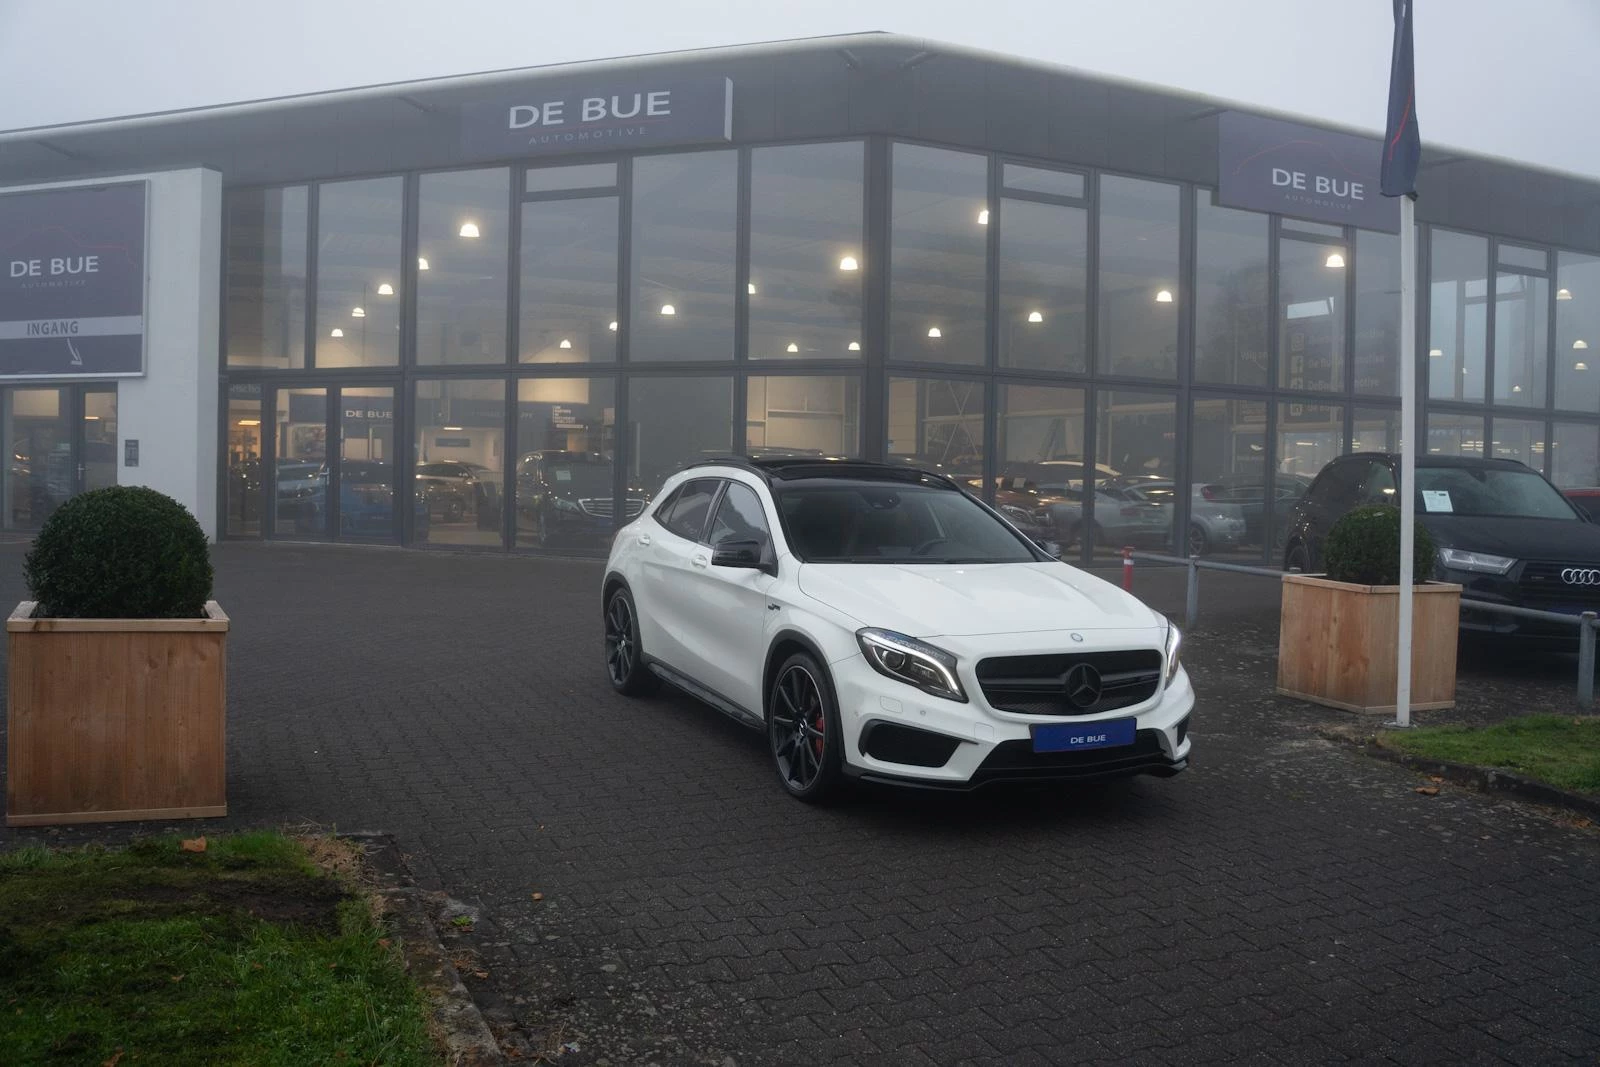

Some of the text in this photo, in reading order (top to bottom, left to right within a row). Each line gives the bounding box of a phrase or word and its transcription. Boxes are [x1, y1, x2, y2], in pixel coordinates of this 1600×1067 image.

[509, 91, 672, 129] DE BUE
[528, 127, 649, 145] AUTOMOTIVE
[1272, 167, 1365, 201] DE BUE
[10, 255, 100, 278] DE BUE
[27, 321, 79, 337] INGANG
[345, 409, 364, 419] DE
[1069, 734, 1107, 745] DE BUE
